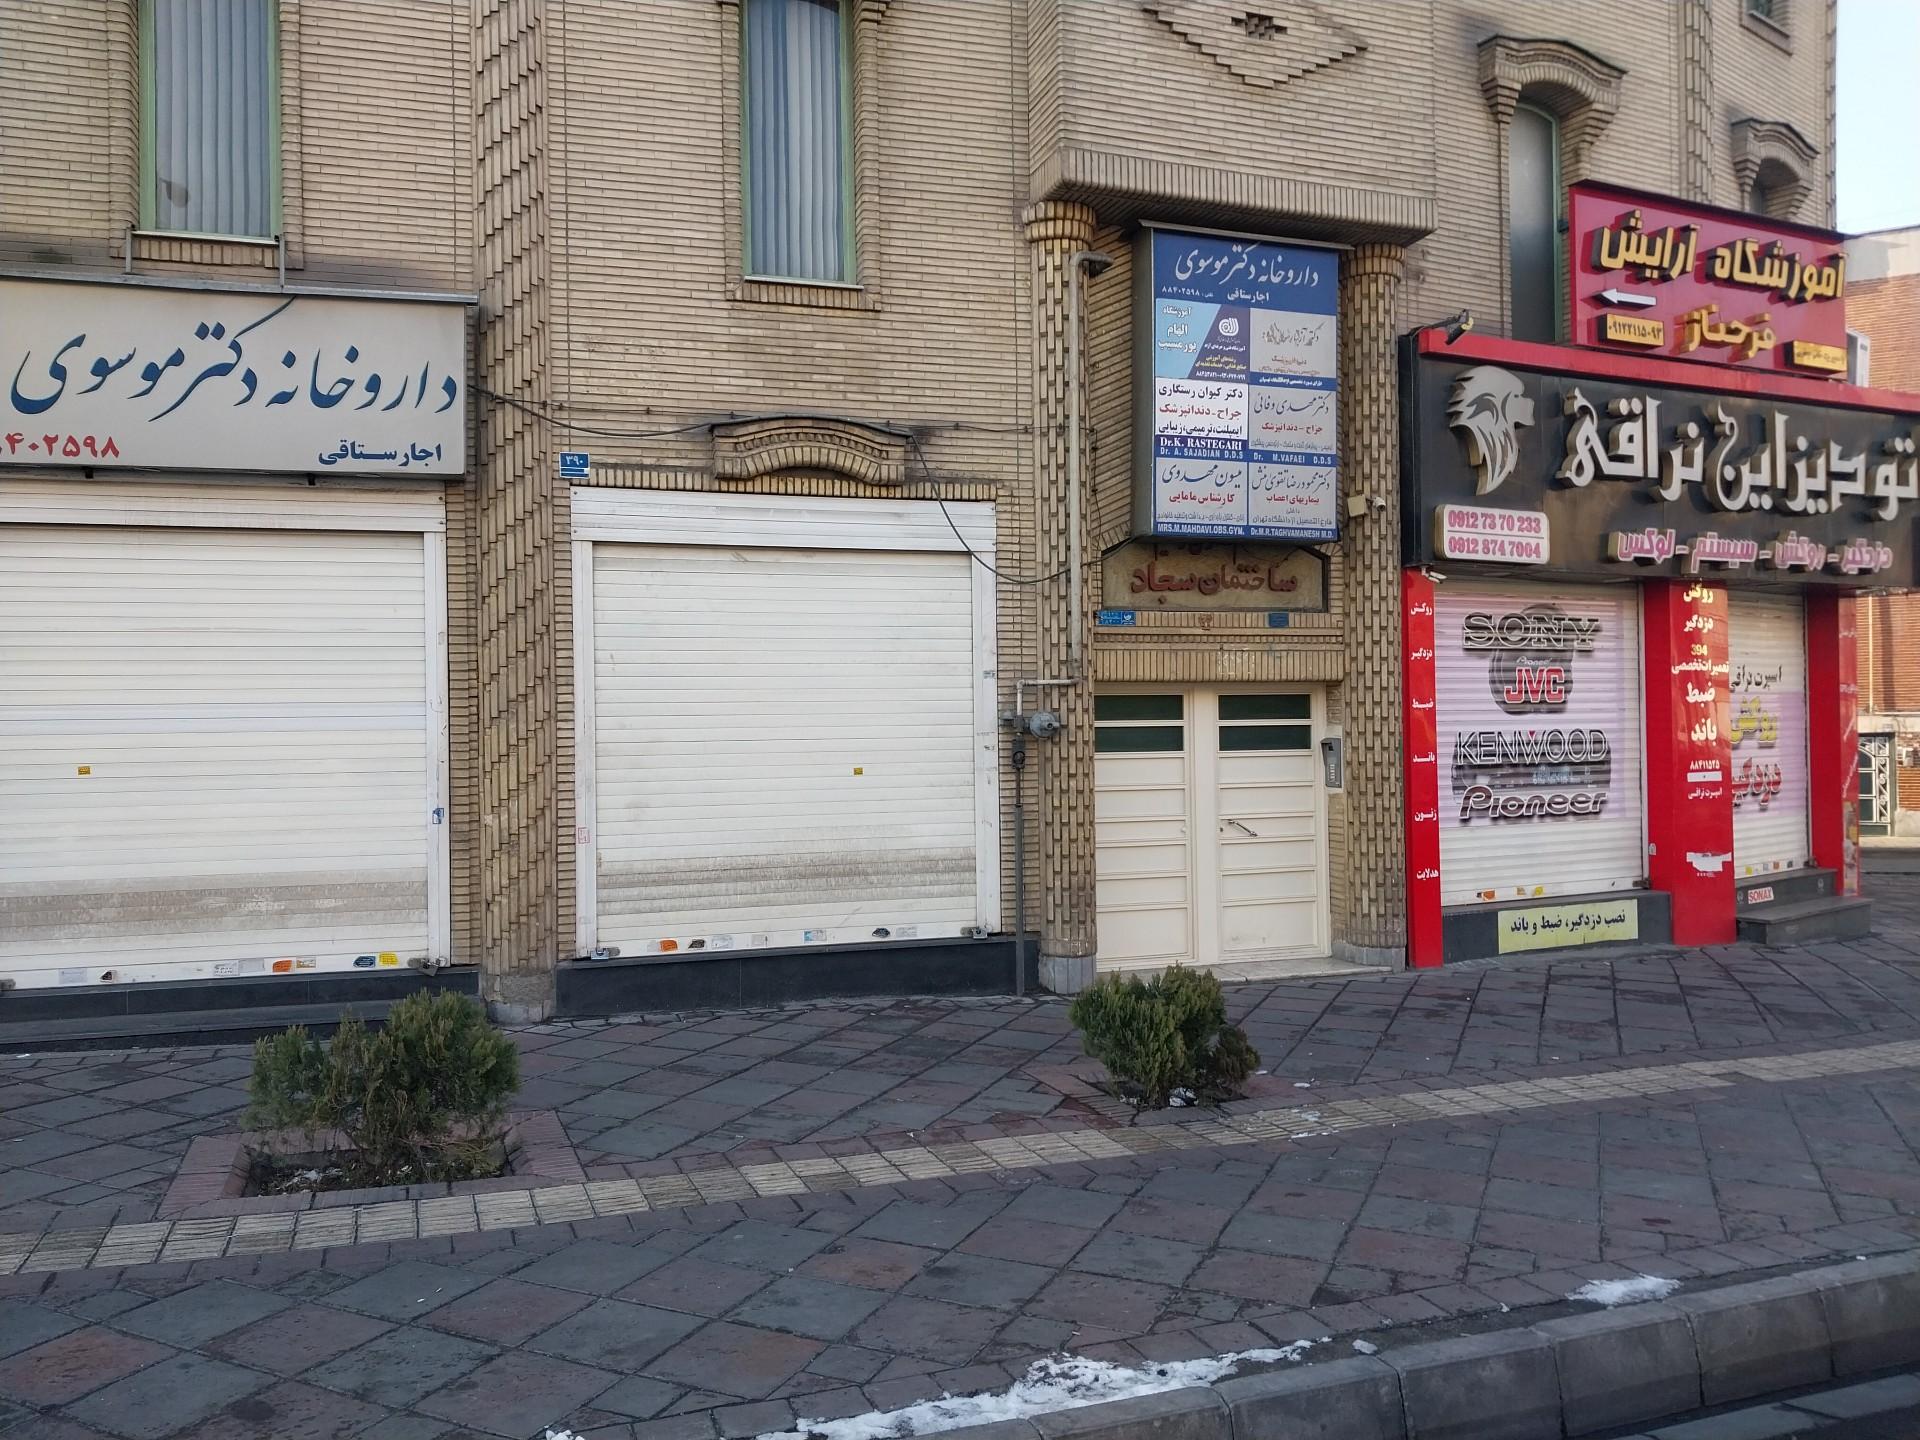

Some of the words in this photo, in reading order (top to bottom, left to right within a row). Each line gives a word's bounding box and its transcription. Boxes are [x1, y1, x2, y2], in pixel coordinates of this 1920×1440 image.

[1600, 209, 1700, 280] آرایش
[1175, 249, 1229, 281] موسوی
[1219, 241, 1261, 285] دکتر
[1257, 255, 1319, 287] داروخانه
[148, 295, 298, 422] دکتر
[10, 333, 185, 415] موسوی
[265, 345, 458, 414] داروخانه
[1158, 383, 1196, 398] رستگاری
[1197, 386, 1222, 399] کیوان
[1224, 388, 1243, 400] دکتر
[1217, 406, 1242, 420] جراح
[0, 432, 120, 458] ۴۰۲۵۹۸
[318, 439, 442, 468] اجارستاقی
[1184, 448, 1220, 458] SAJADIAN
[1187, 438, 1242, 450] RASTEGARI
[1448, 510, 1478, 529] 0912
[1480, 512, 1497, 530] 73
[1499, 514, 1515, 531] 70
[1517, 516, 1541, 534] 233
[1448, 536, 1479, 554] 0912
[1617, 528, 1676, 564] لوکس
[1463, 611, 1601, 650] SONY
[1504, 666, 1565, 704] JVC
[1685, 681, 1716, 708] ضبط
[1691, 718, 1717, 746] باند
[1457, 728, 1608, 765] KENWOOD
[1459, 785, 1607, 819] Pioneer
[1511, 916, 1529, 934] باند
[1540, 914, 1562, 932] ضبط
[1604, 910, 1626, 928] نصب
